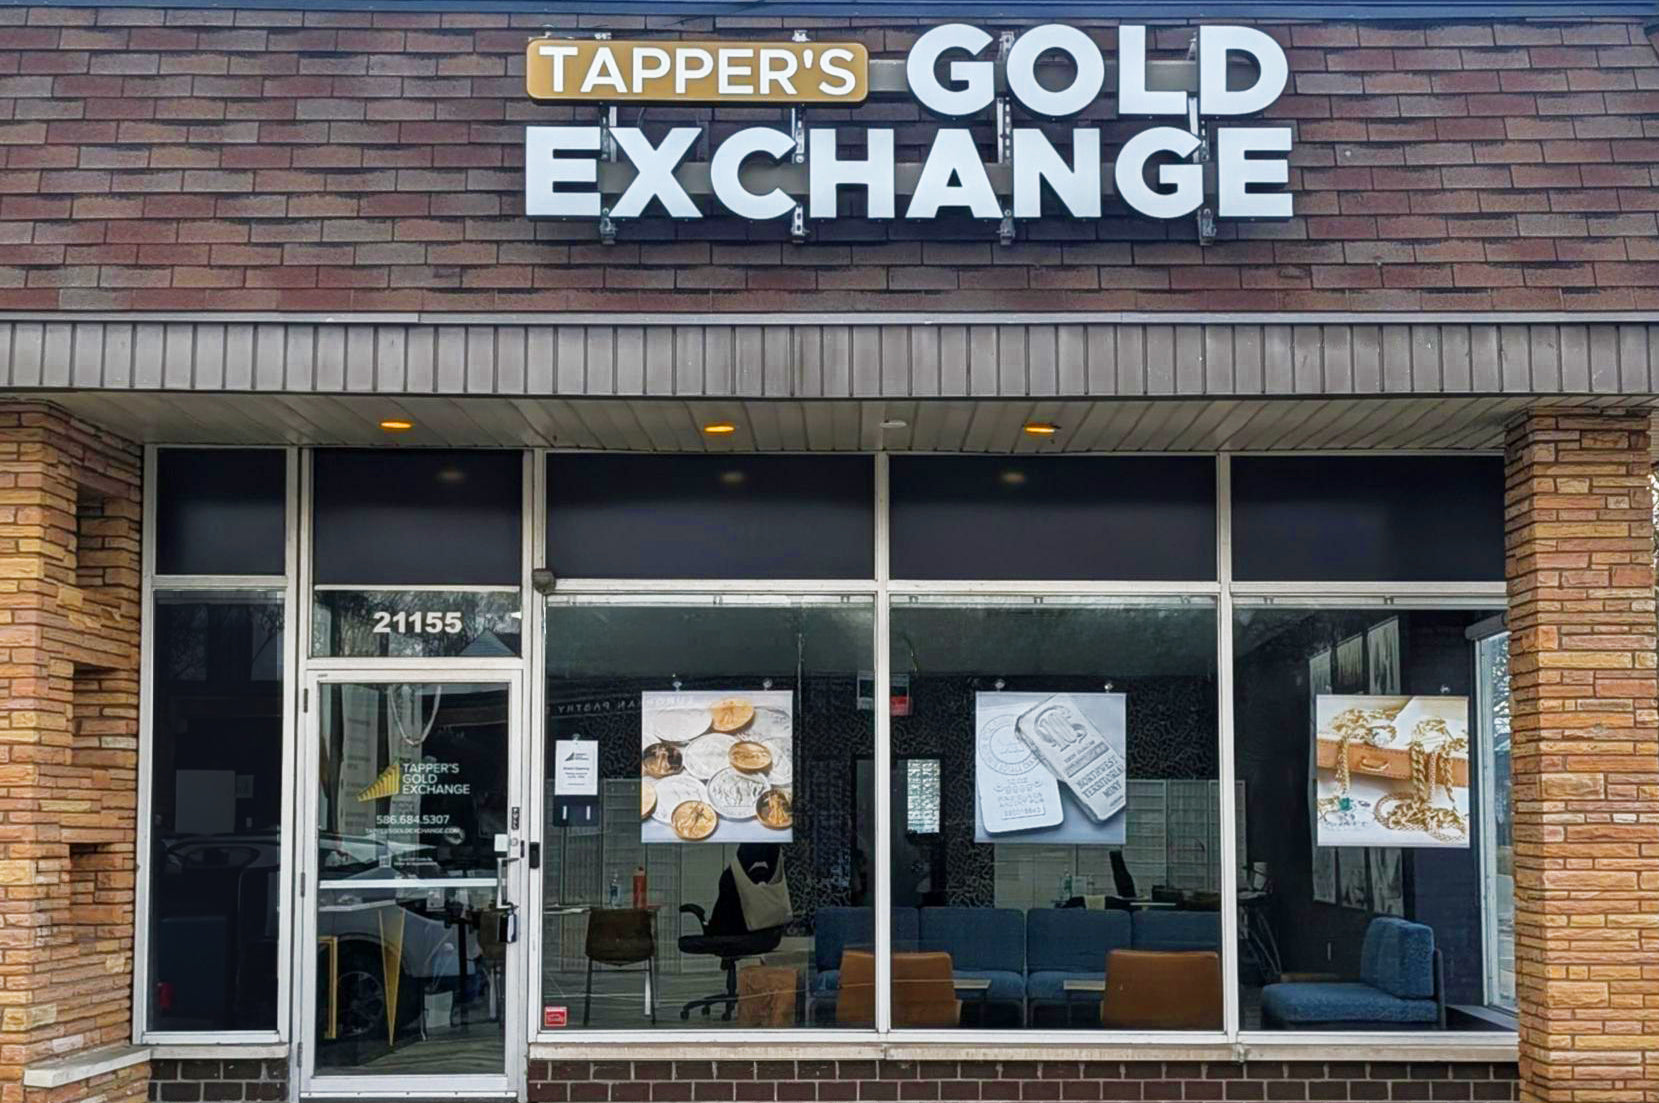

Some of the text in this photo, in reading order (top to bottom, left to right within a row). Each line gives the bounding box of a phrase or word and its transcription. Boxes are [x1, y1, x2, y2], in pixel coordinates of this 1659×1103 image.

[538, 24, 1288, 117] TAPPER'S GOLD
[526, 126, 1294, 219] EXCHANGE
[372, 611, 462, 634] 21155
[402, 763, 460, 774] TAPPER'S
[402, 773, 438, 785] GOLD
[402, 784, 471, 795] EXCHANGE
[376, 815, 450, 825] 586.684.5307
